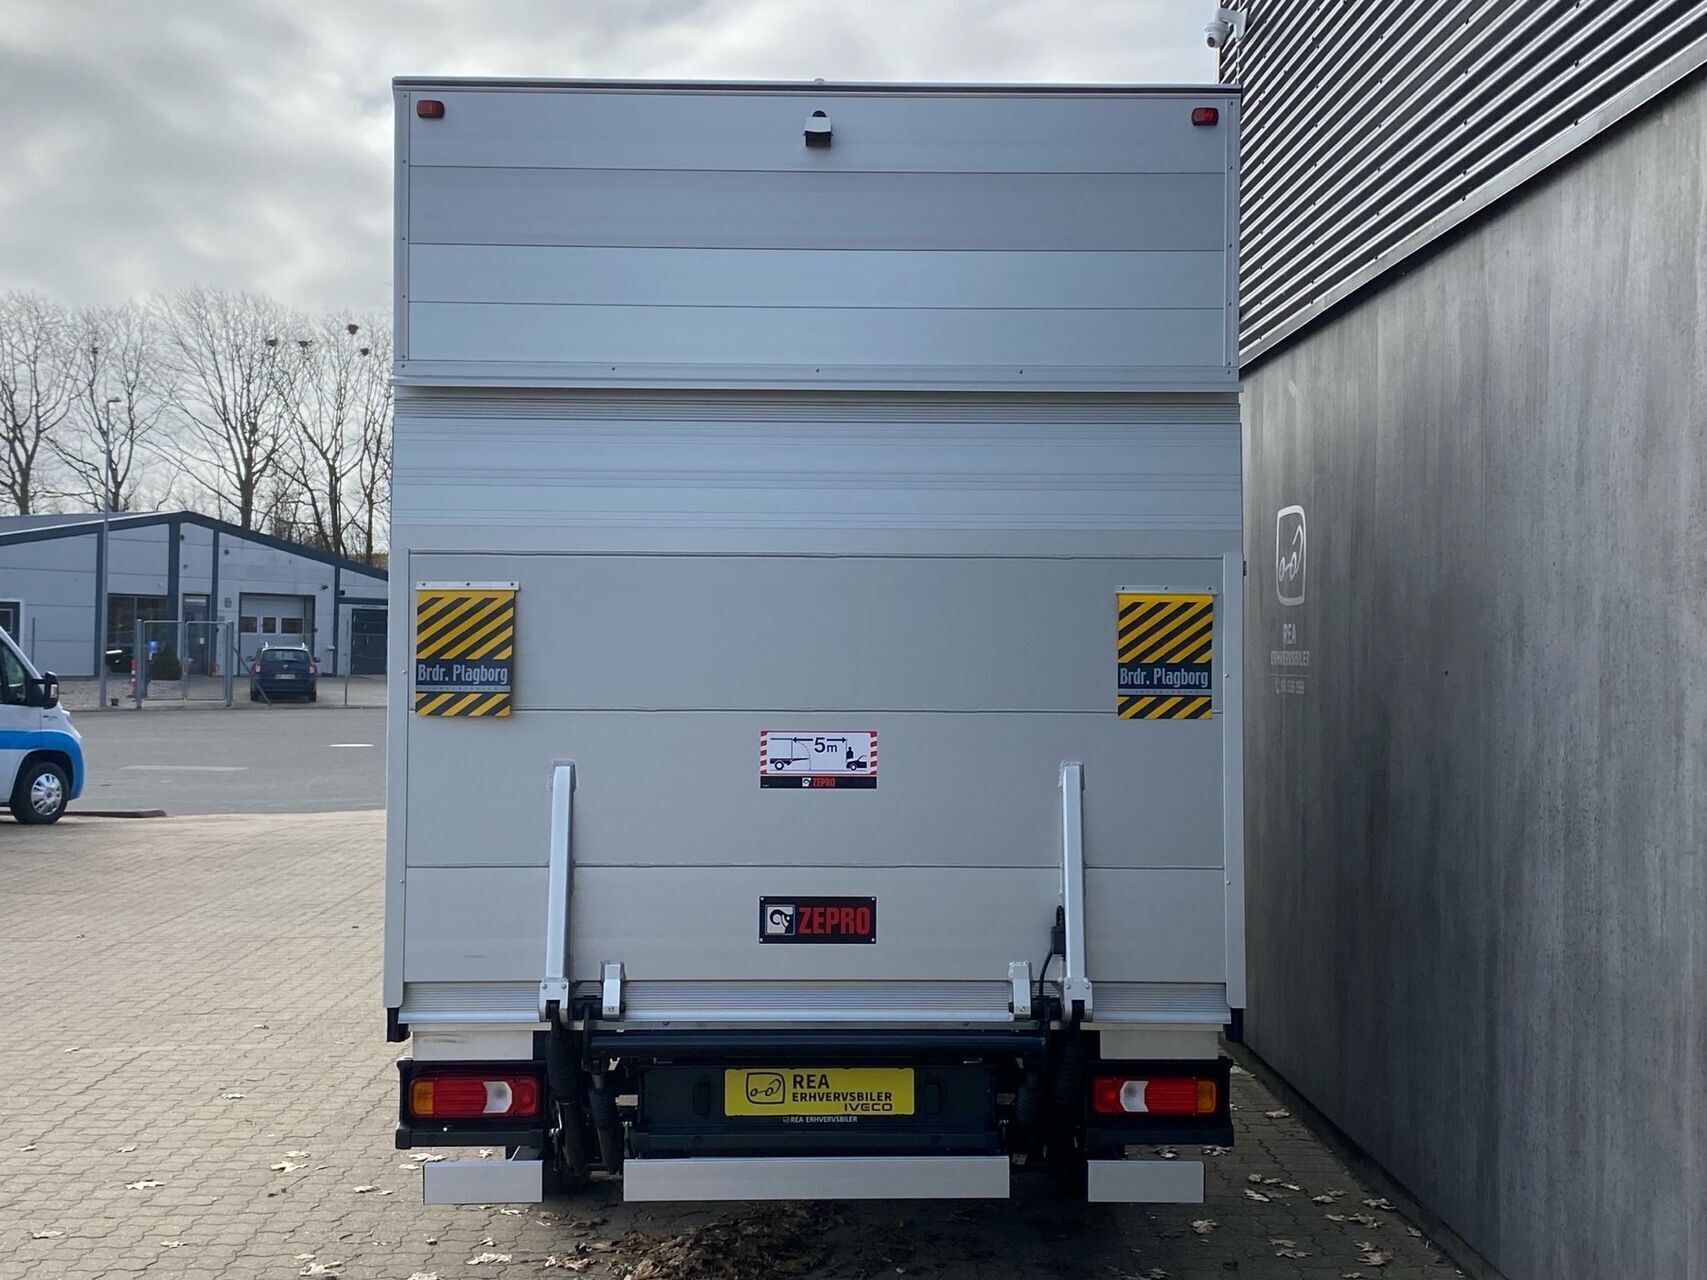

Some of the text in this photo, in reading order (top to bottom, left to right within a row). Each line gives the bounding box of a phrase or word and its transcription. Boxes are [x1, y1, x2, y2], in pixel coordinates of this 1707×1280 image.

[1283, 623, 1297, 645] REA
[418, 664, 508, 685] Brdr. Plagborg
[1120, 668, 1209, 688] Brdr. Plagborg
[814, 737, 838, 753] 5m
[812, 777, 836, 787] ZEPRO
[798, 906, 870, 935] ZEPRO
[793, 1074, 830, 1089] REA
[792, 1092, 892, 1102] ERHVERVSBILER
[844, 1103, 893, 1112] IVECO
